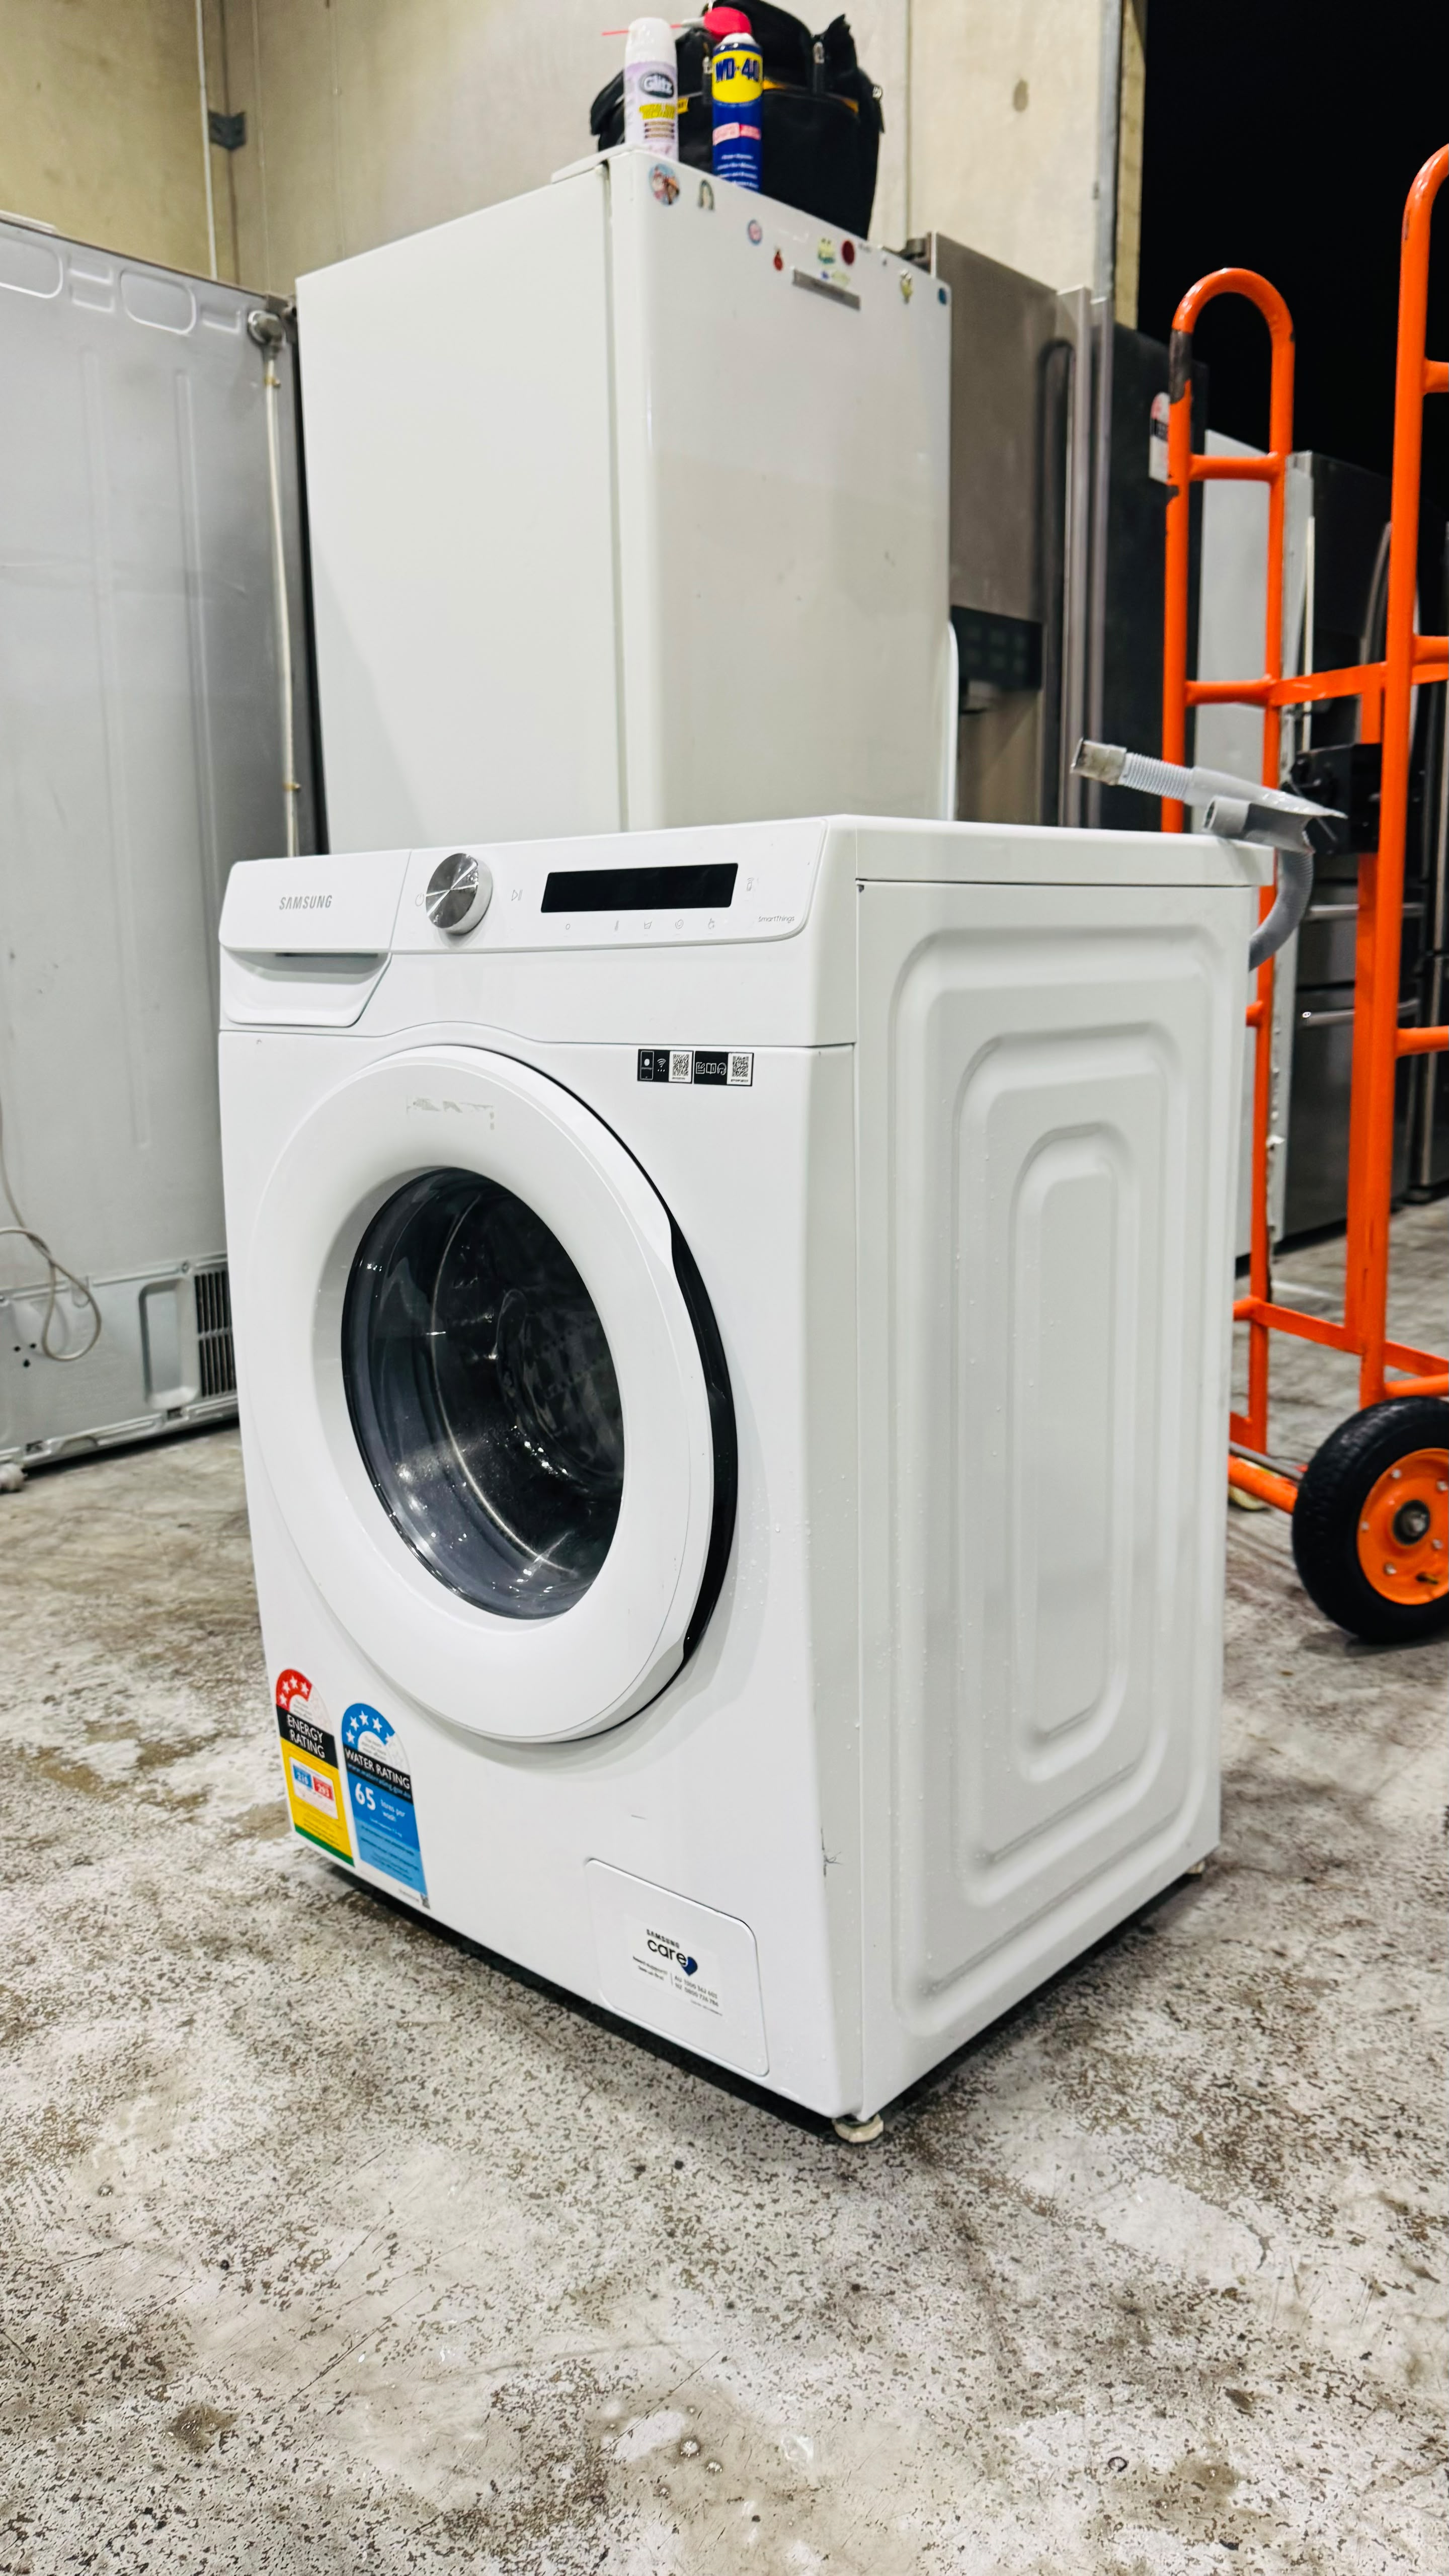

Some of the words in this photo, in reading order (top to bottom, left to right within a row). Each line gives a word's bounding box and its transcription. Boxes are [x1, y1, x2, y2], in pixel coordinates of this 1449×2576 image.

[715, 57, 760, 83] WD-40
[643, 74, 673, 95] Glitz
[279, 895, 332, 910] SAMSUNG
[758, 915, 794, 923] SmartThings
[286, 1714, 323, 1743] ENERGY
[289, 1729, 326, 1758] RATING
[344, 1747, 375, 1772] WATER
[375, 1763, 411, 1790] RATING
[355, 1783, 376, 1811] 65
[647, 1928, 680, 1949] SAMSUNG
[647, 1939, 687, 1966] care
